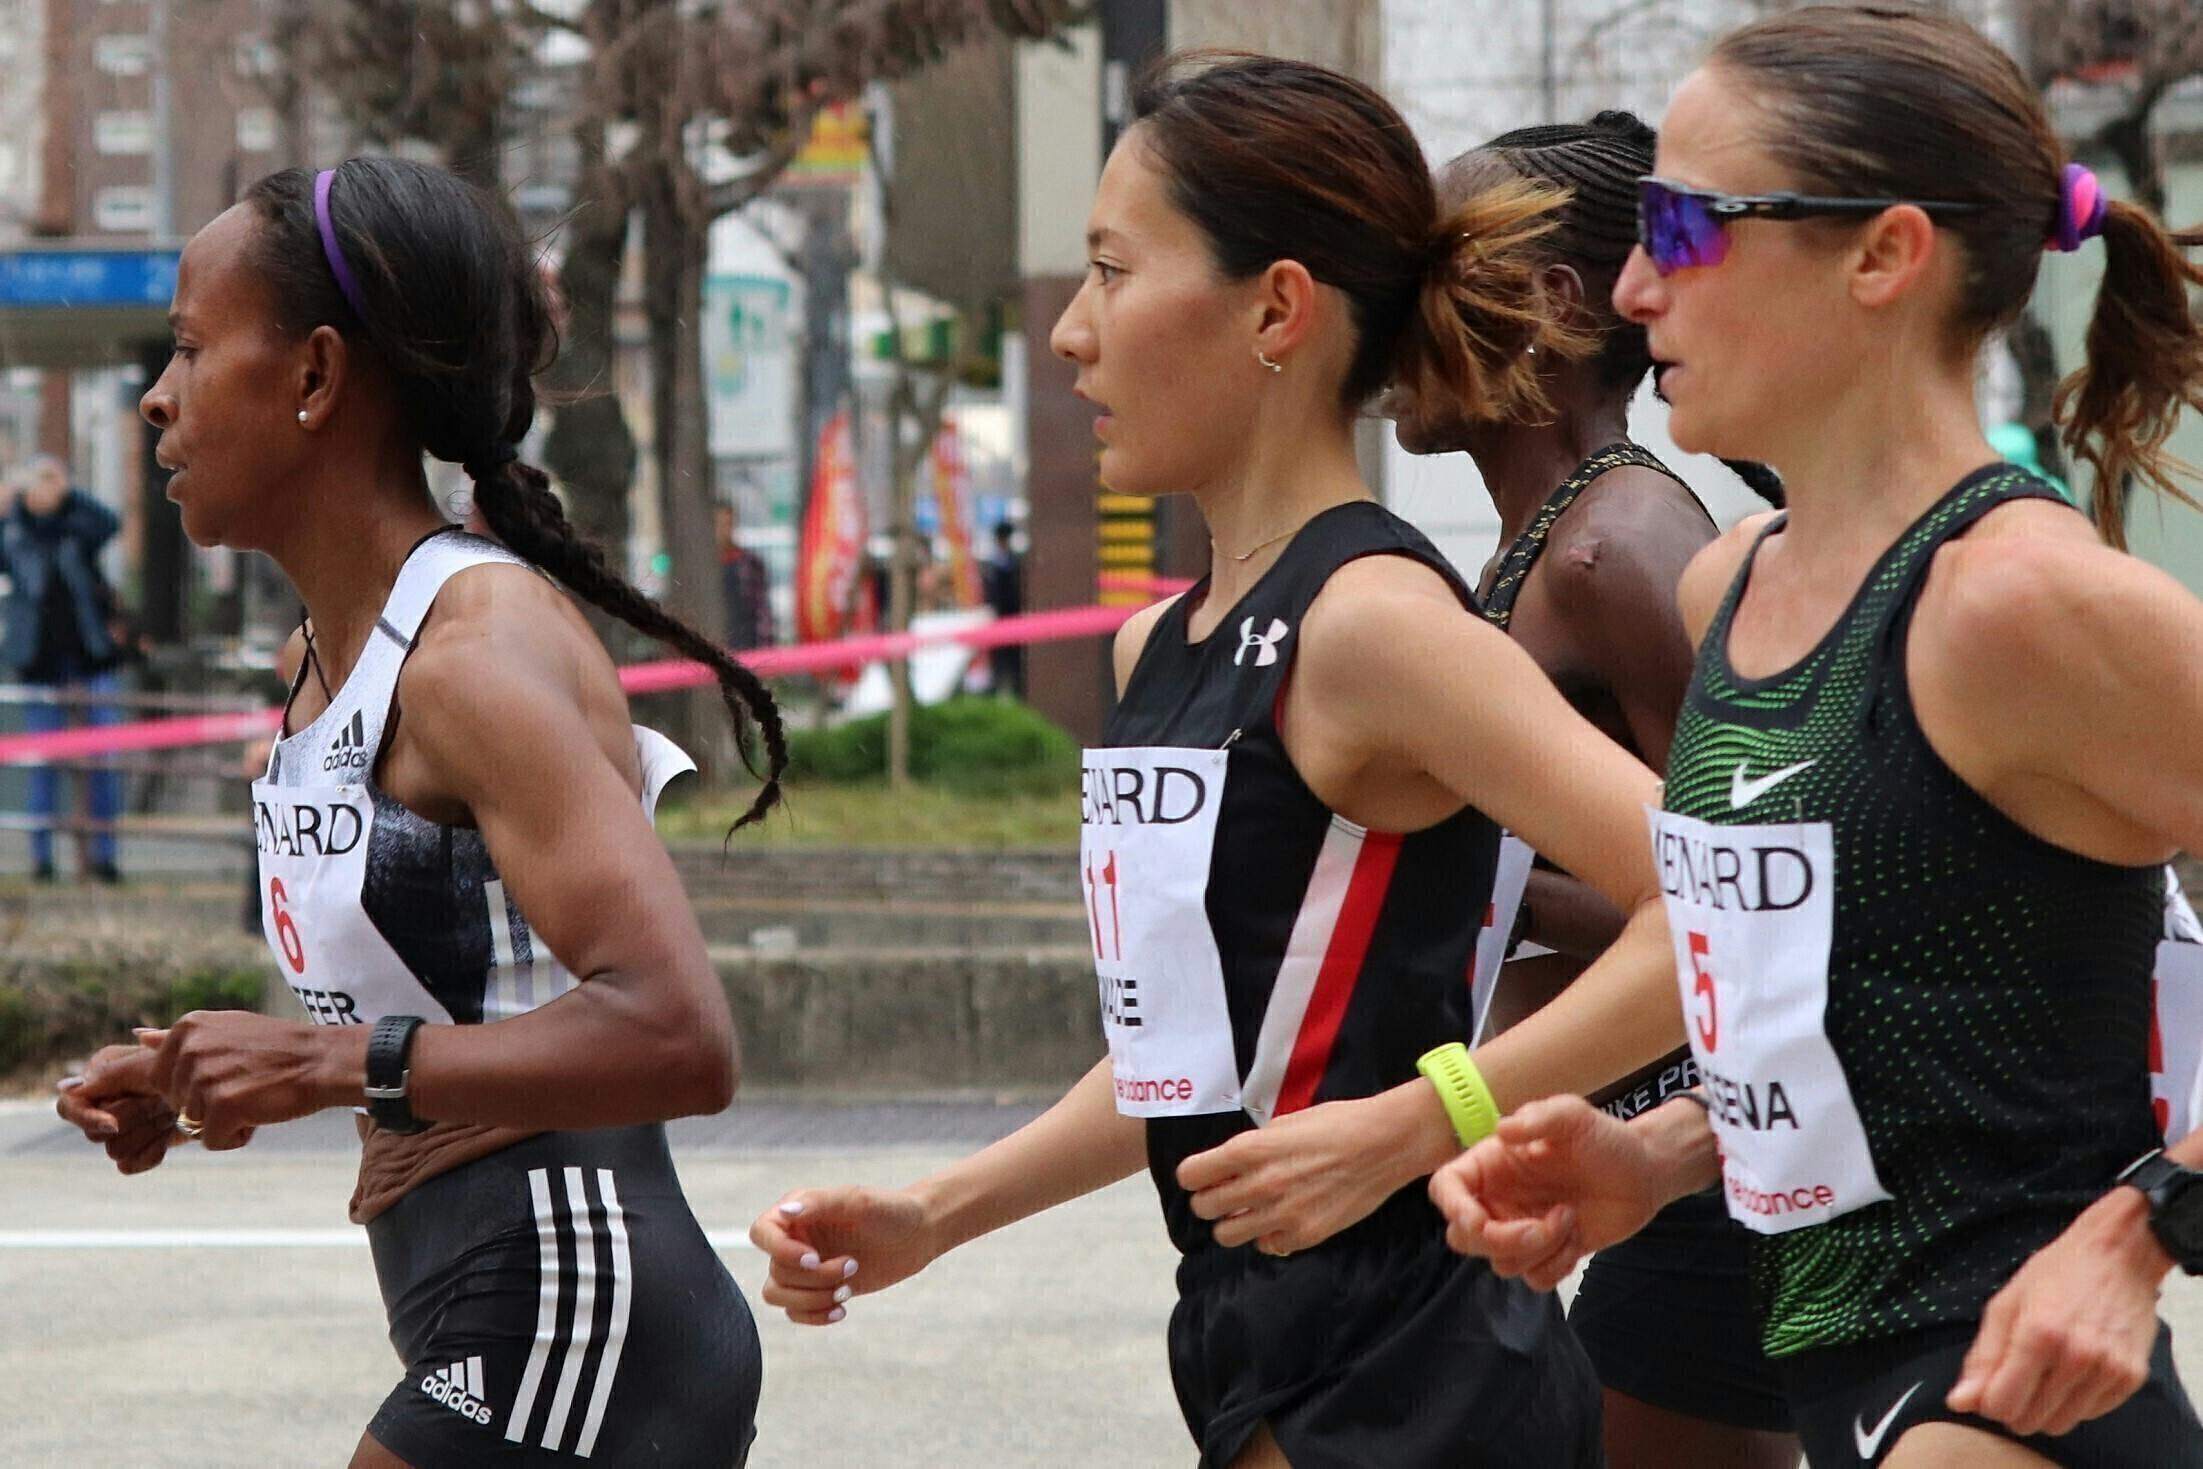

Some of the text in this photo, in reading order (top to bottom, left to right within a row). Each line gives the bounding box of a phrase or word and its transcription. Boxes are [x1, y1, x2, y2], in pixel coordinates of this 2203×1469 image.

[270, 876, 305, 974] 6
[1688, 930, 1717, 1054] 5
[421, 1375, 492, 1425] adidas
